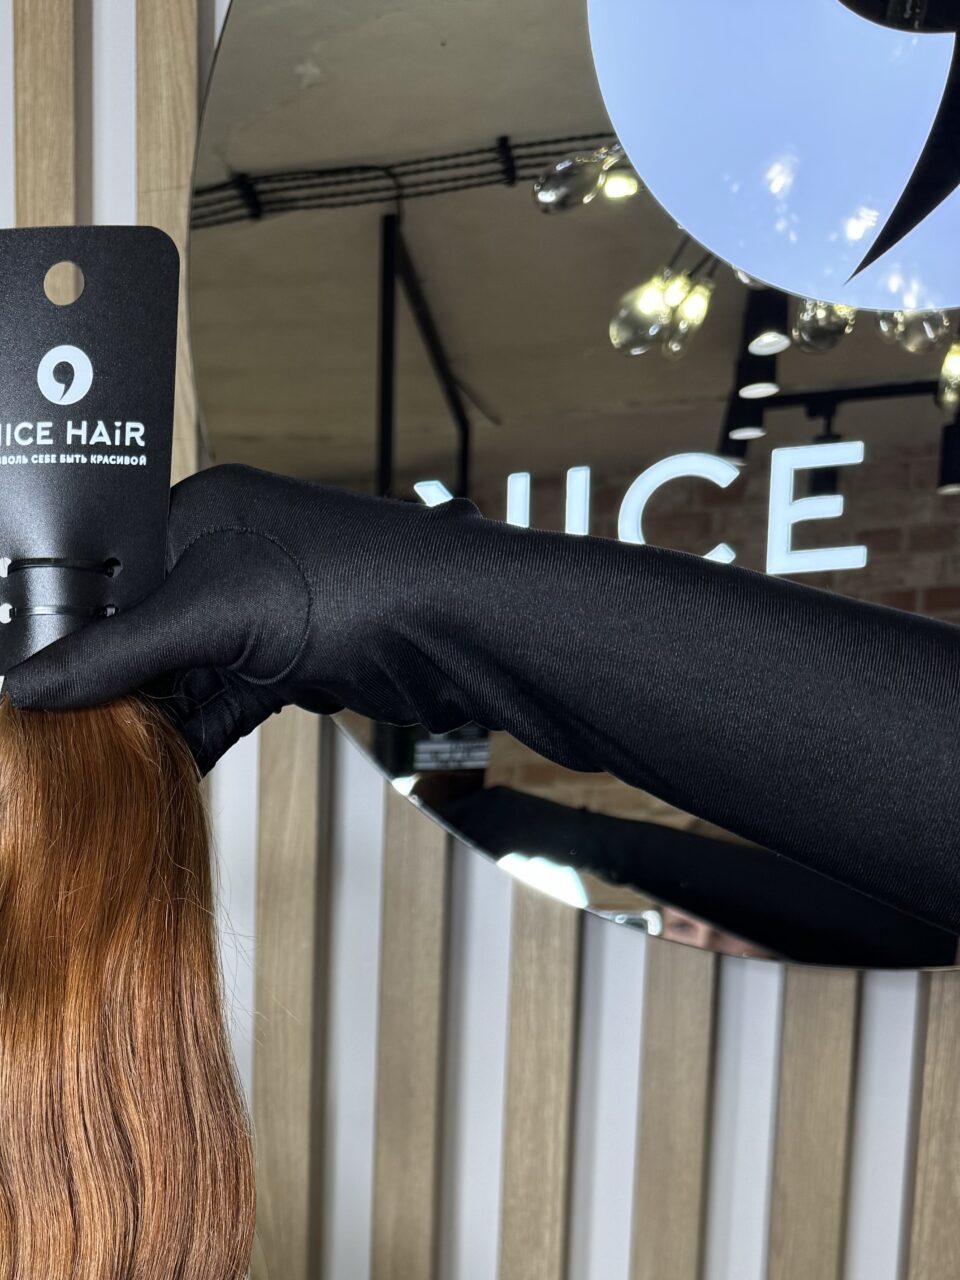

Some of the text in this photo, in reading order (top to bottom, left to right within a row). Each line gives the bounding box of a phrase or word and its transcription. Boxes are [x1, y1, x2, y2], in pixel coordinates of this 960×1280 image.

[31, 454, 57, 464] СЕБЕ
[59, 454, 88, 464] БЫТЬ
[90, 454, 147, 466] КРАСИВОЙ
